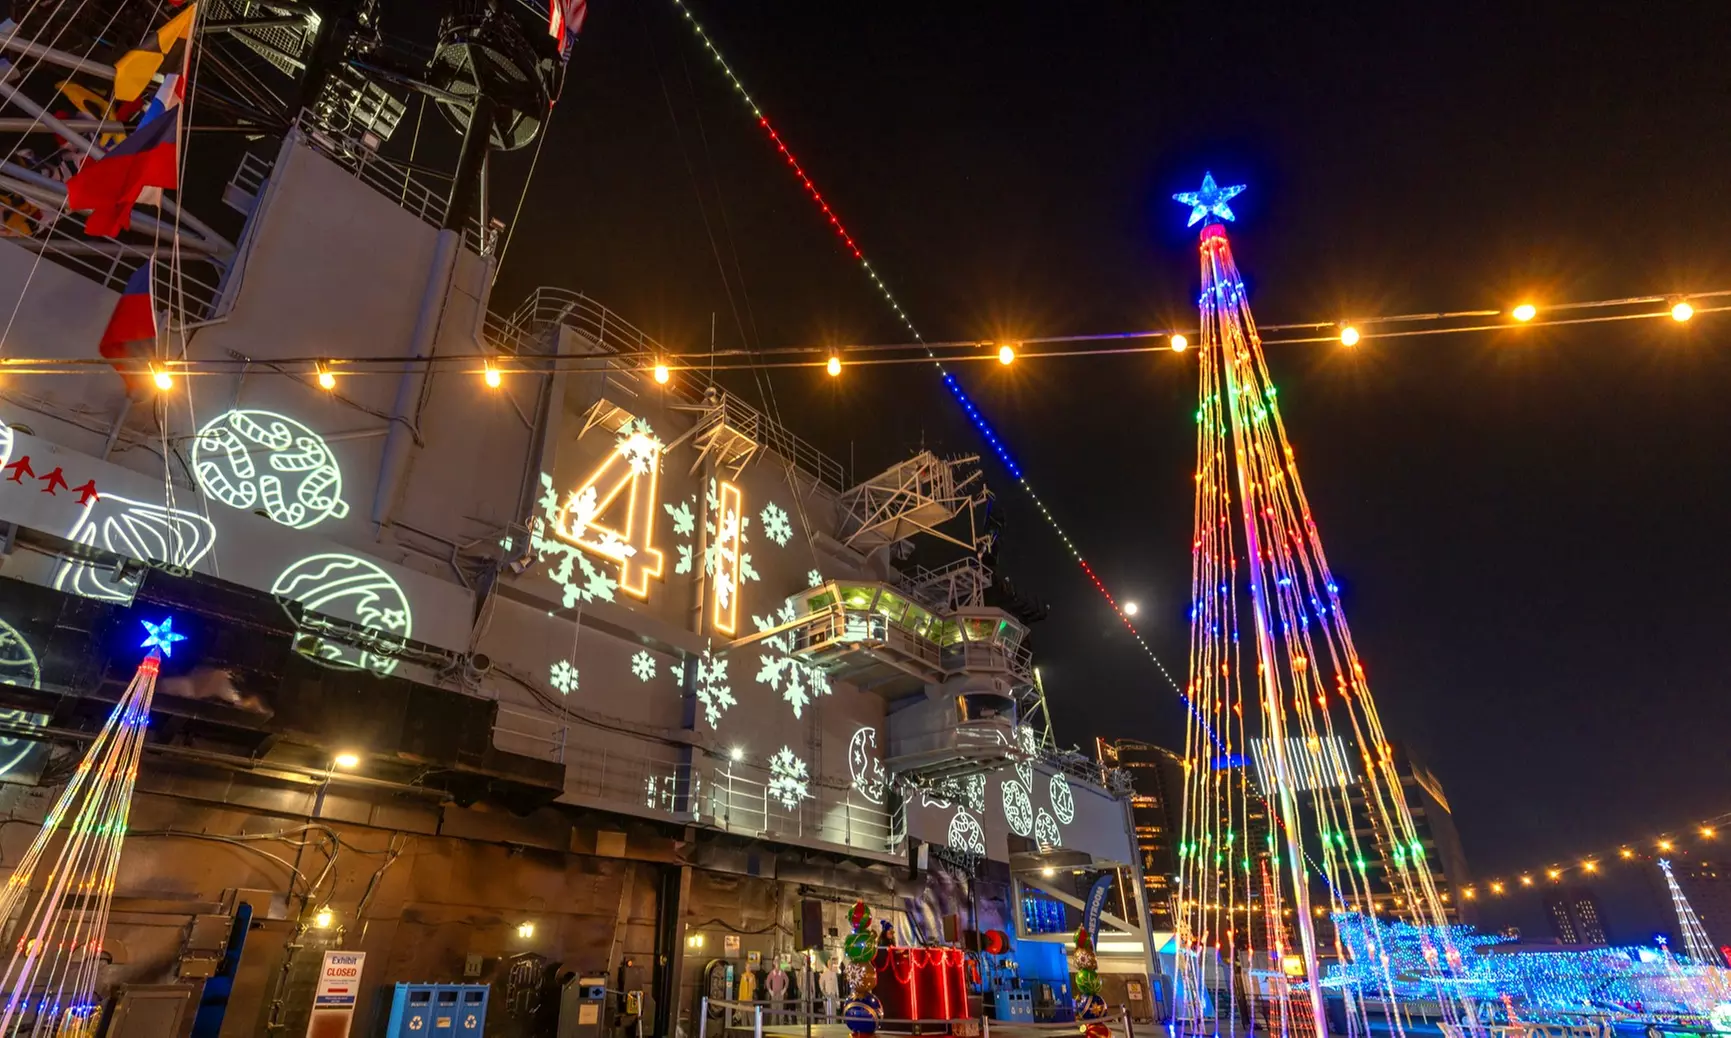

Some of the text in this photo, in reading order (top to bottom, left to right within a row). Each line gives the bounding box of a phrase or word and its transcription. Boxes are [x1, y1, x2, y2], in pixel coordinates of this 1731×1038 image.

[1089, 886, 1105, 934] RESTROOM
[332, 956, 357, 965] Exhibit
[326, 968, 357, 977] CLOSED
